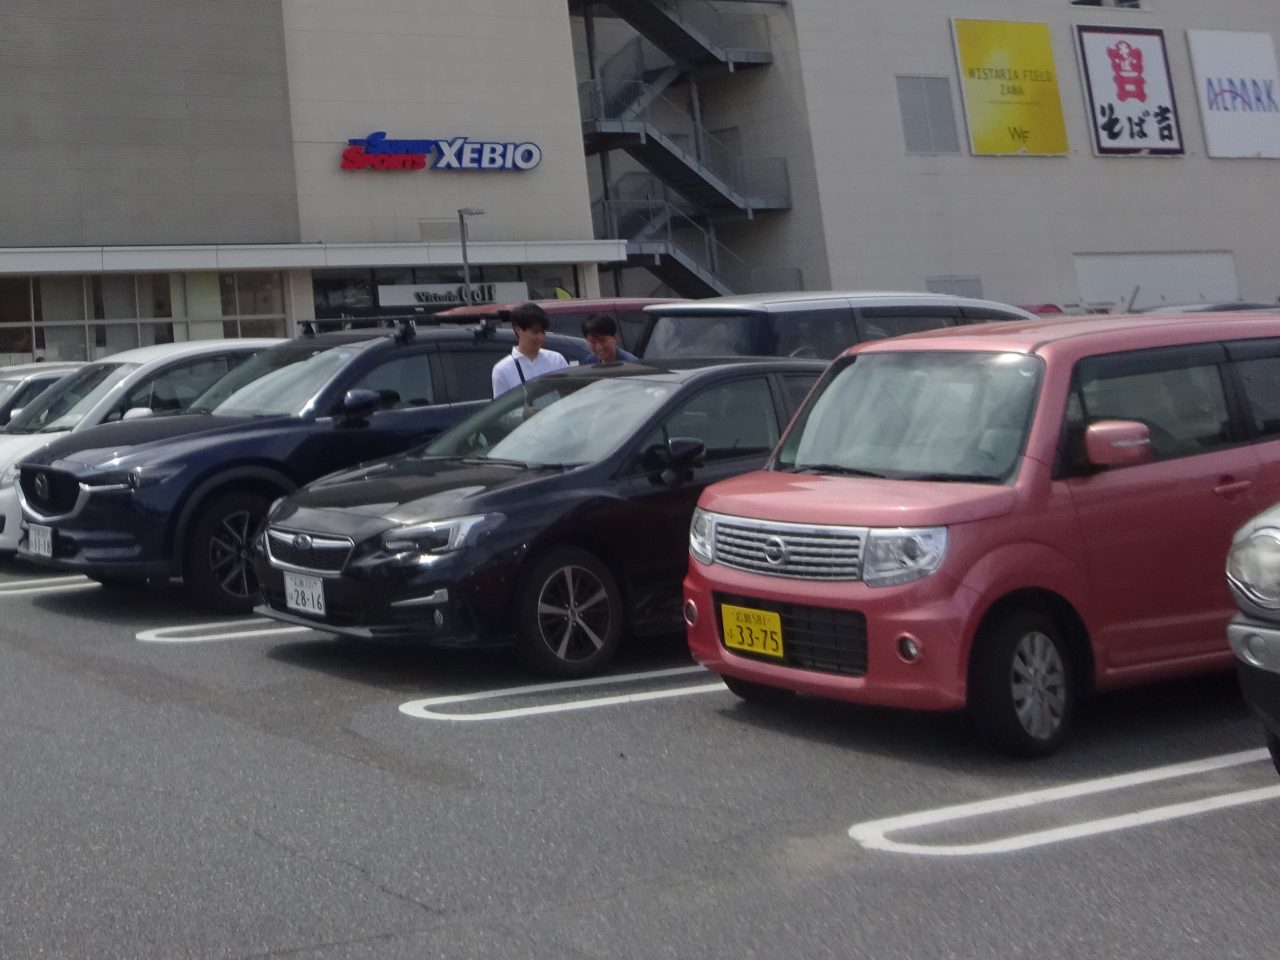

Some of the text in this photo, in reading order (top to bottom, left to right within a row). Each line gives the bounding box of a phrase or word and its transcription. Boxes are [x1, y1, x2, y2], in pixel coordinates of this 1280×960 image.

[968, 67, 1053, 82] WISTARIA FIELD
[1206, 76, 1280, 114] ALPARK
[435, 138, 541, 170] XEBIO
[736, 624, 779, 652] 33-75
